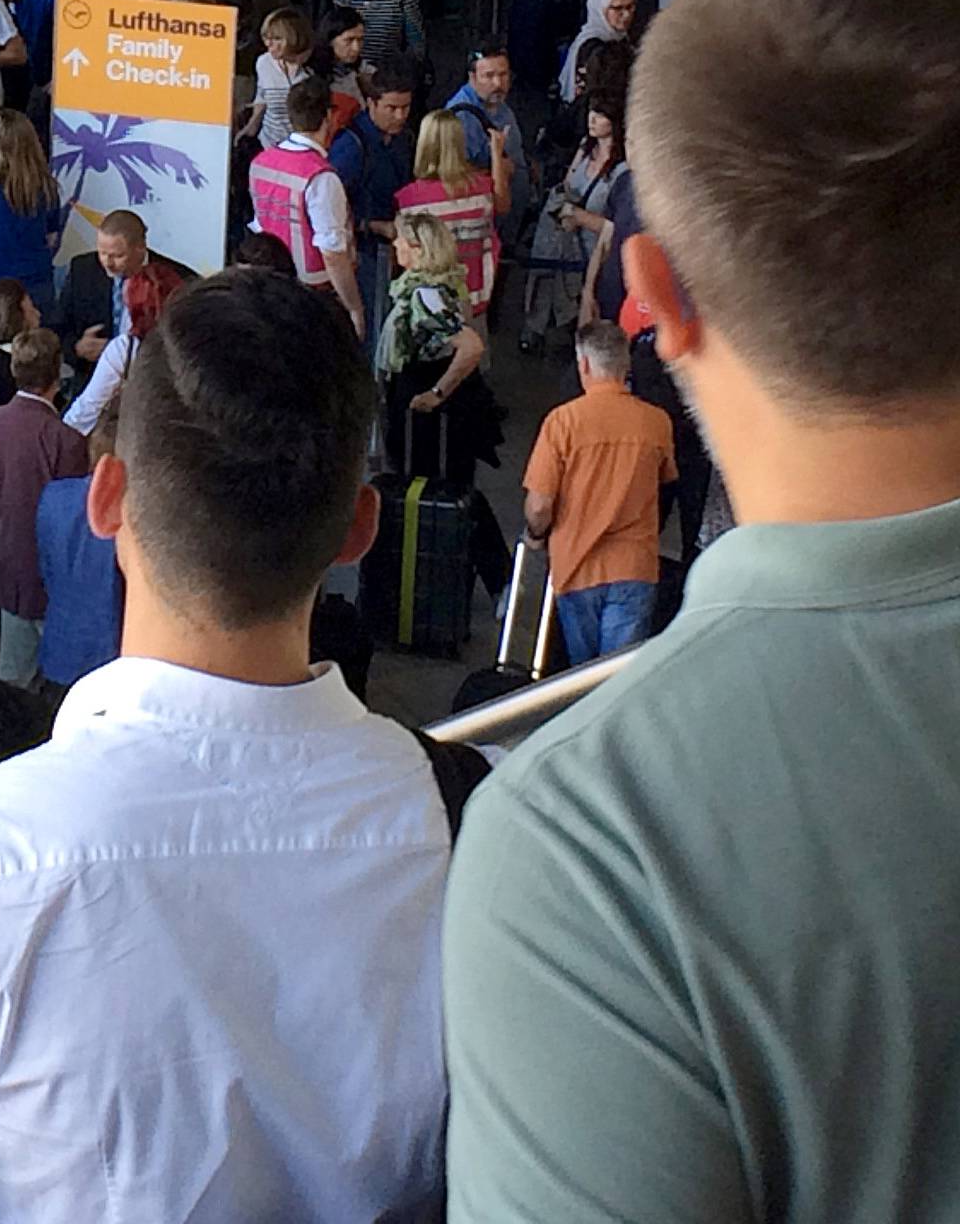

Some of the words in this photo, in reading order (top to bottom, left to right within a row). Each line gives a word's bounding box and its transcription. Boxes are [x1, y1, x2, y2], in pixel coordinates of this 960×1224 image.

[108, 8, 227, 39] Lufthansa
[106, 33, 184, 64] Family
[106, 59, 212, 90] Check-in
